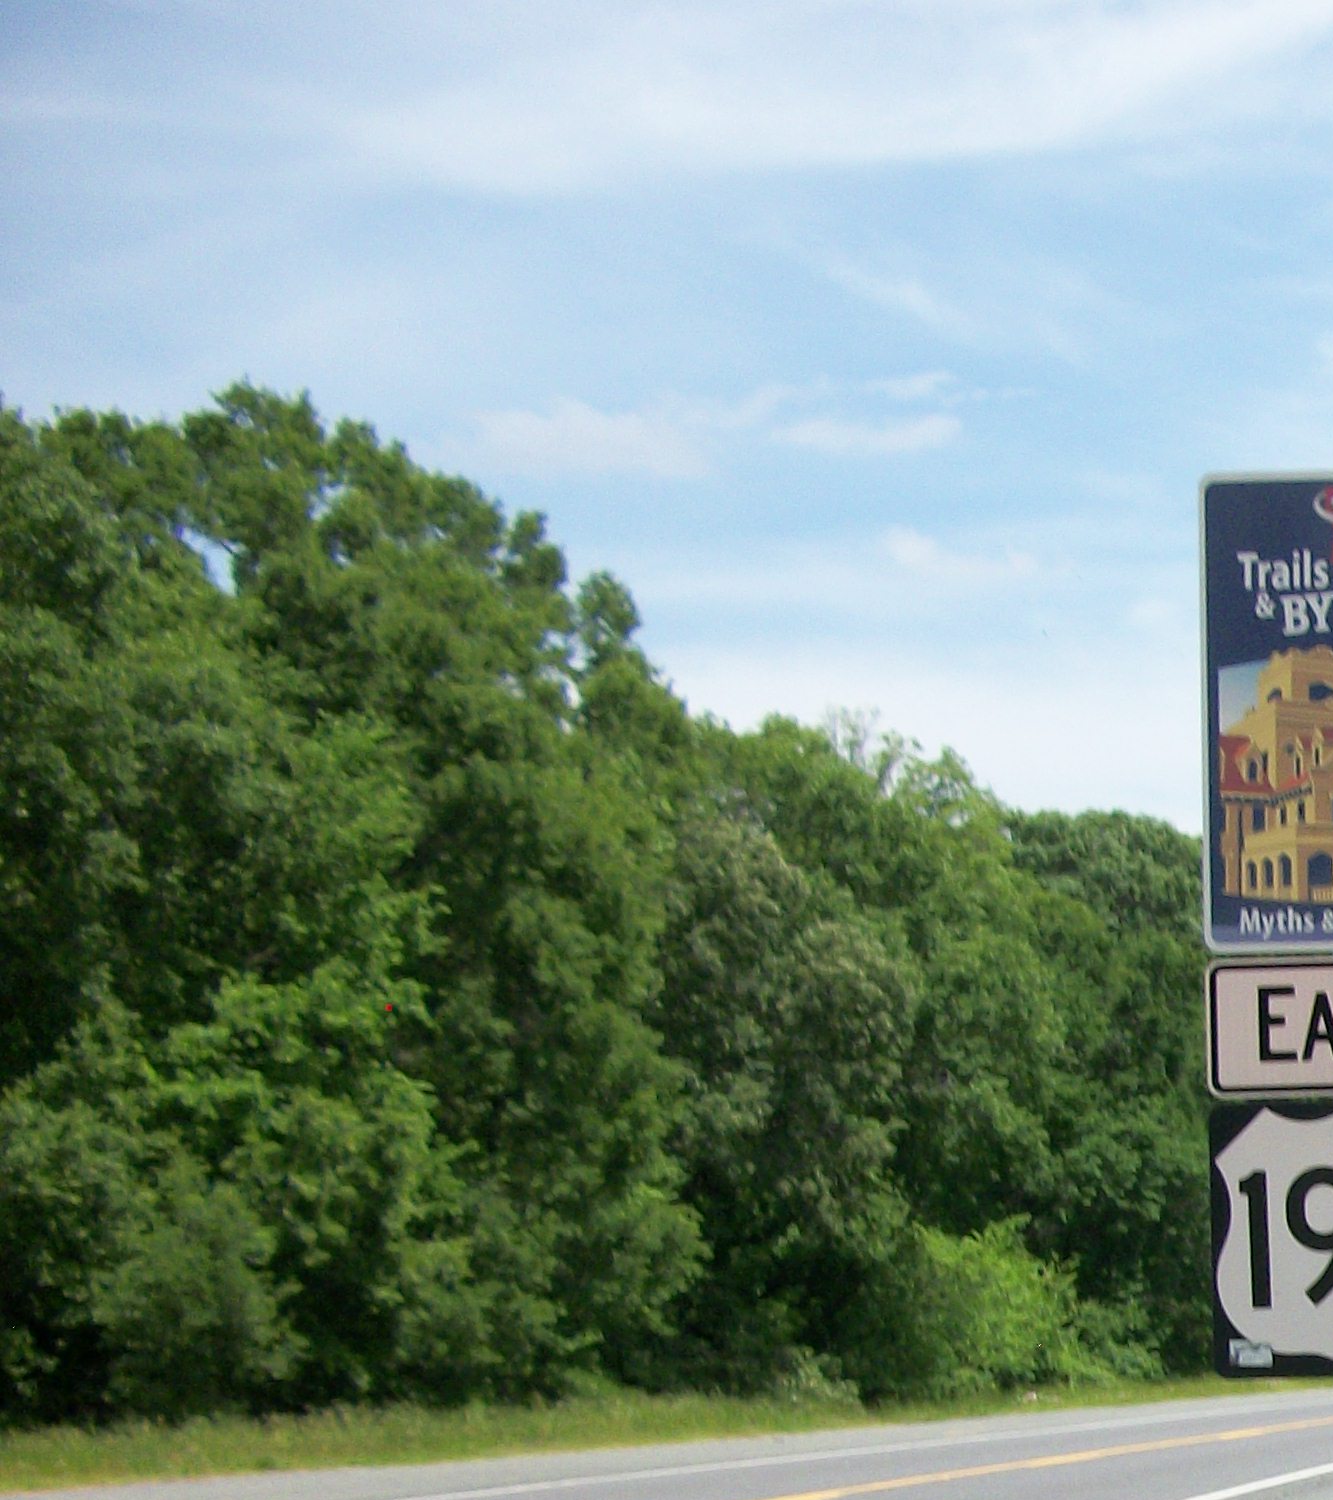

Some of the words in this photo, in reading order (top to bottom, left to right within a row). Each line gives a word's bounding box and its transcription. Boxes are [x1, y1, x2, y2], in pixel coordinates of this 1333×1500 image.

[1237, 549, 1330, 592] Trails
[1255, 591, 1276, 620] &
[1239, 904, 1315, 941] Myths
